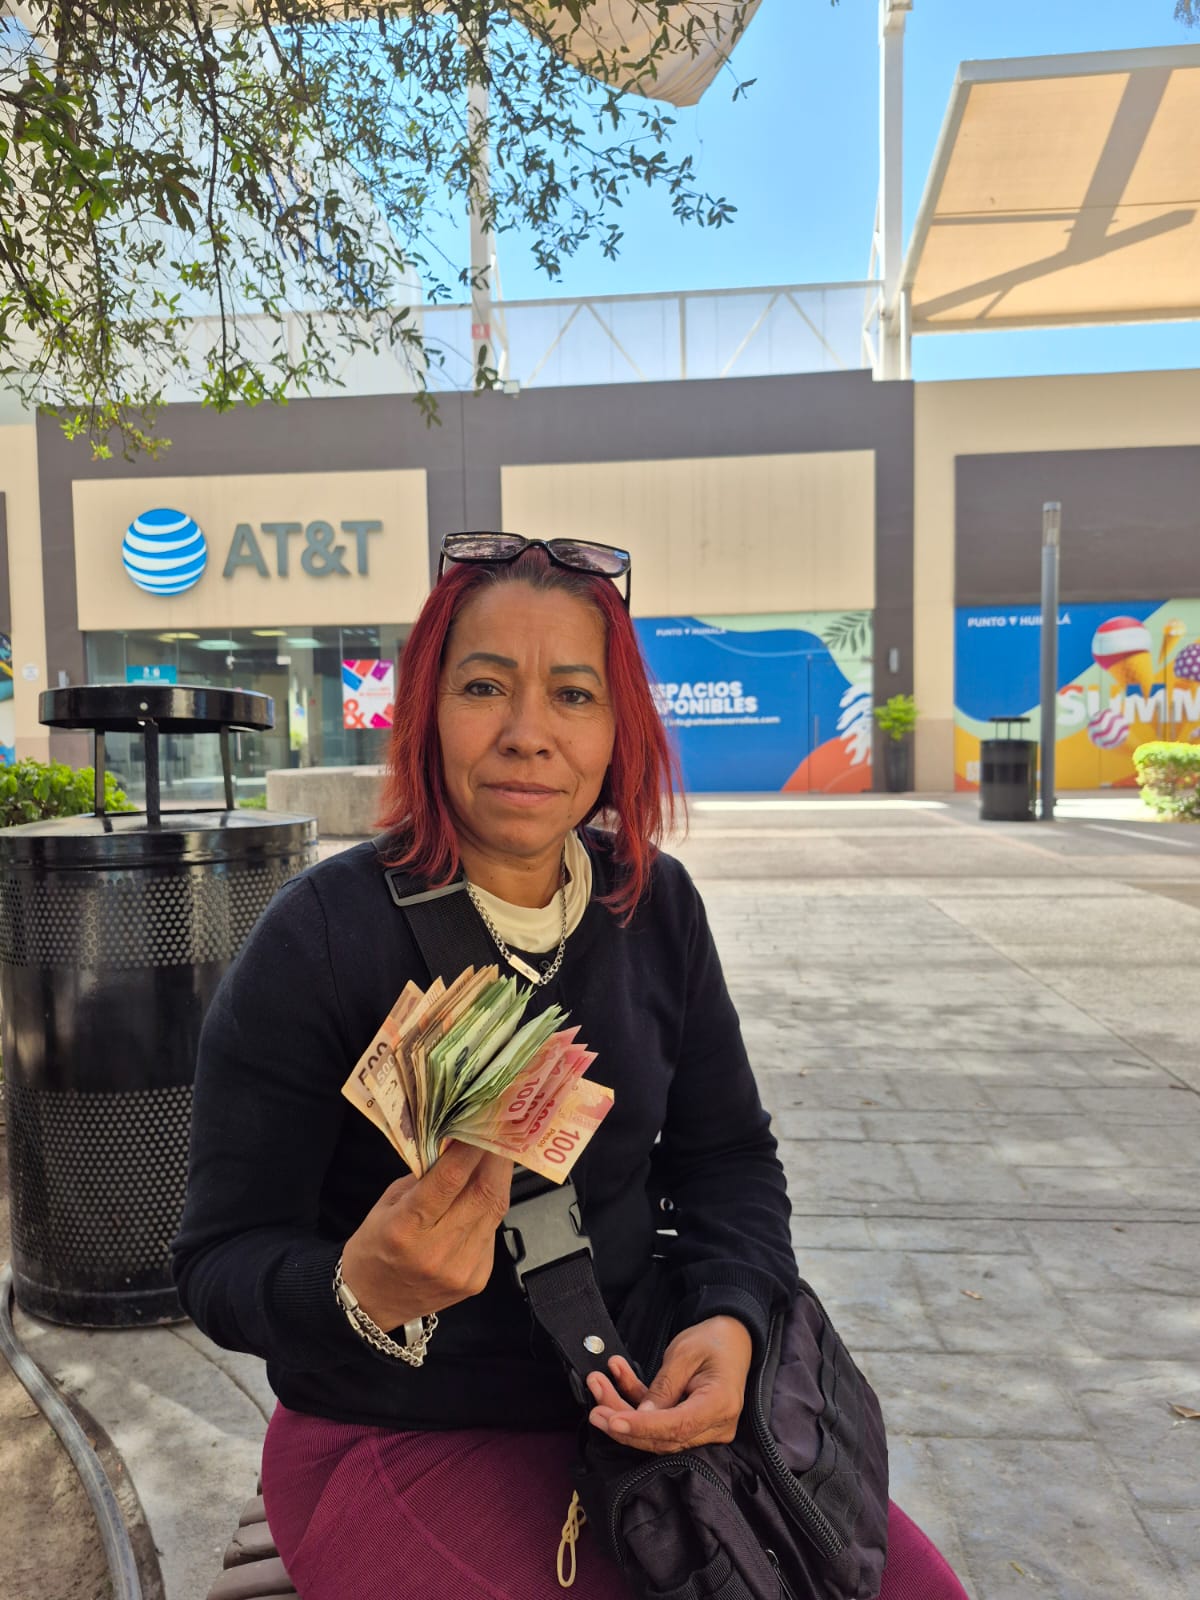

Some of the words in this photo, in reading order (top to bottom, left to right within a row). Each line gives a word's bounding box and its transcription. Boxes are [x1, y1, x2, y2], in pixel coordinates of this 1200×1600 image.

[223, 519, 383, 578] AT&T
[967, 615, 1006, 628] PUNTO
[1019, 611, 1071, 627] HUILÁ
[508, 1077, 540, 1113] 100
[543, 1128, 581, 1165] 100
